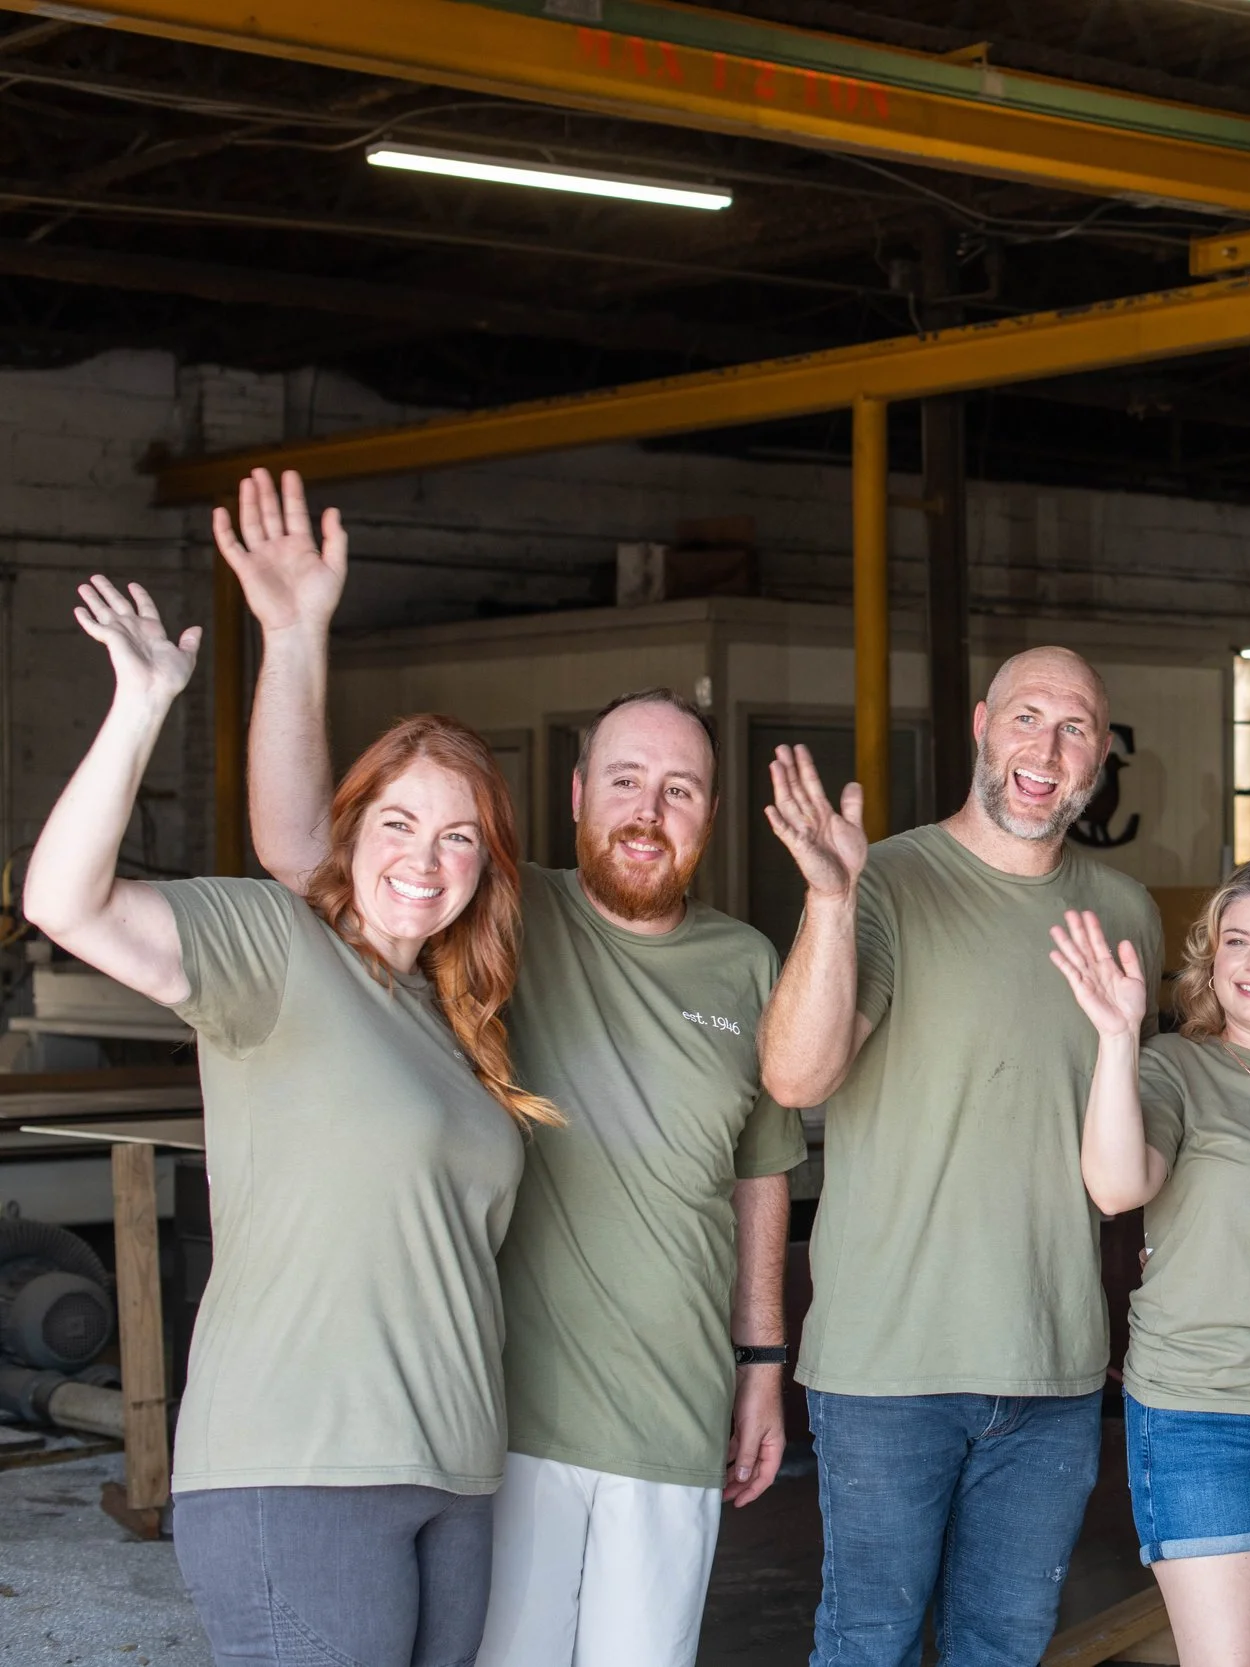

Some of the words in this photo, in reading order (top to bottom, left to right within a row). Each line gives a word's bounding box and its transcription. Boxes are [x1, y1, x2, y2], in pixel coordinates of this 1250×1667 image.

[572, 27, 684, 85] MAX
[795, 68, 890, 121] TON
[682, 1011, 708, 1025] est.
[710, 1015, 741, 1035] 1946
